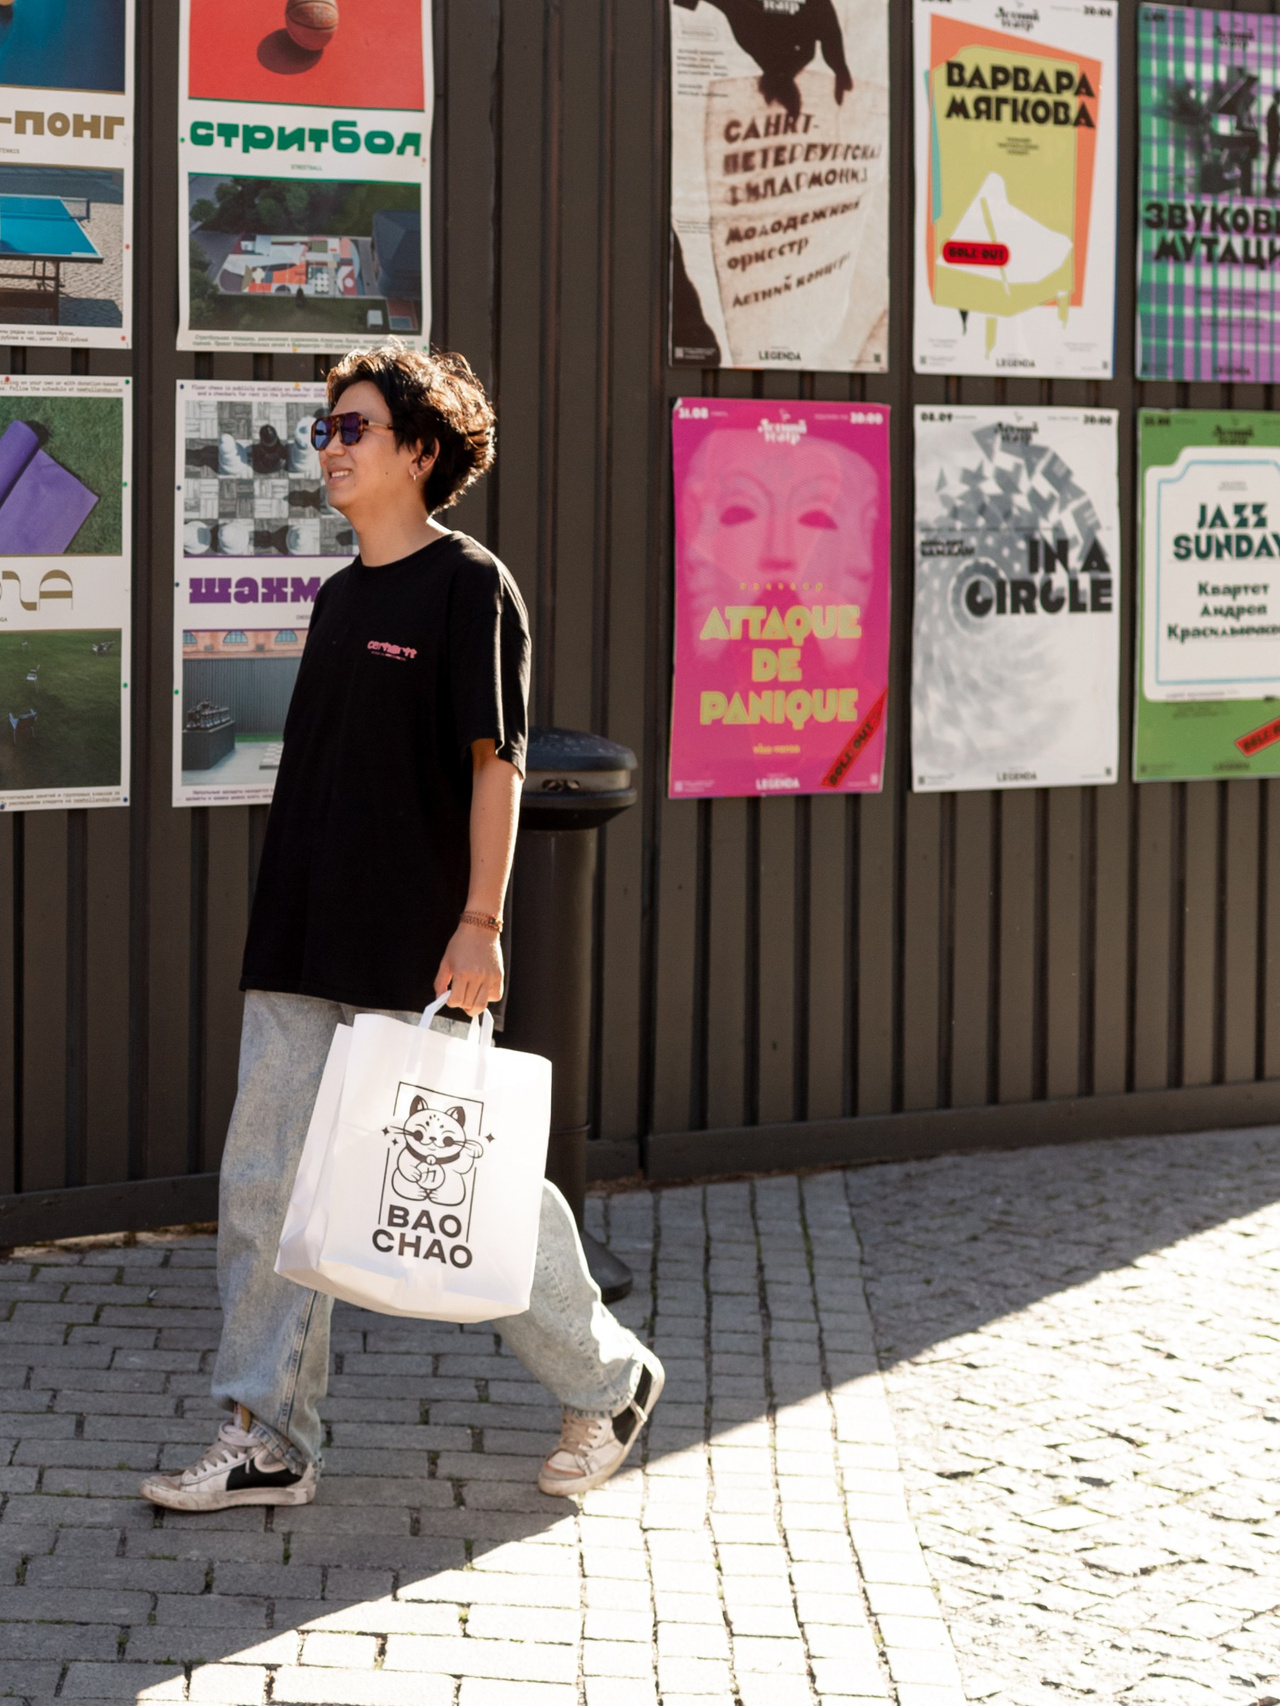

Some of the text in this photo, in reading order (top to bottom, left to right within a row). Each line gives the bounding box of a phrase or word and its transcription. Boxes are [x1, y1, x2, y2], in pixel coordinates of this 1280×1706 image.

[946, 61, 1096, 98] ВАРВАРА
[945, 96, 1096, 129] МЯГКОВА
[758, 351, 802, 362] LEGENDA
[1197, 503, 1268, 529] JAZZ
[1028, 537, 1111, 573] IN A
[189, 577, 321, 603] шахм
[965, 580, 1112, 618] CIRCLE
[1197, 580, 1269, 601] Квартет
[699, 605, 862, 646] ATTAQUE
[751, 648, 803, 682] DE
[699, 688, 859, 730] PANIQUE
[386, 1204, 463, 1239] BAO
[372, 1229, 474, 1269] CHAO
